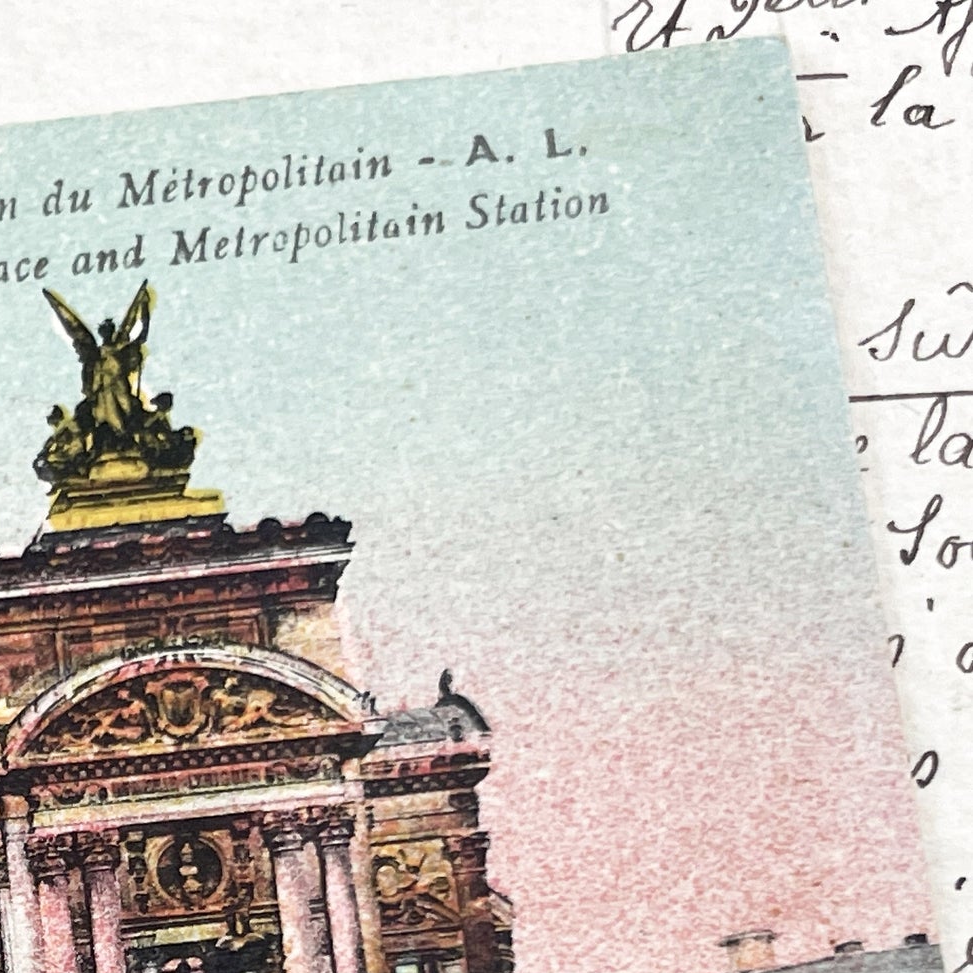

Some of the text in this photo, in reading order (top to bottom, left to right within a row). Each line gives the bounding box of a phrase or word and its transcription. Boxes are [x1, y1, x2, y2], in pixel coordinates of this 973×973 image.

[42, 178, 93, 217] du
[116, 146, 393, 209] Métropolitain
[465, 134, 515, 167] A.
[544, 127, 588, 159] L.
[71, 233, 146, 276] and
[168, 203, 446, 265] Metropolitain
[465, 187, 610, 230] Station
